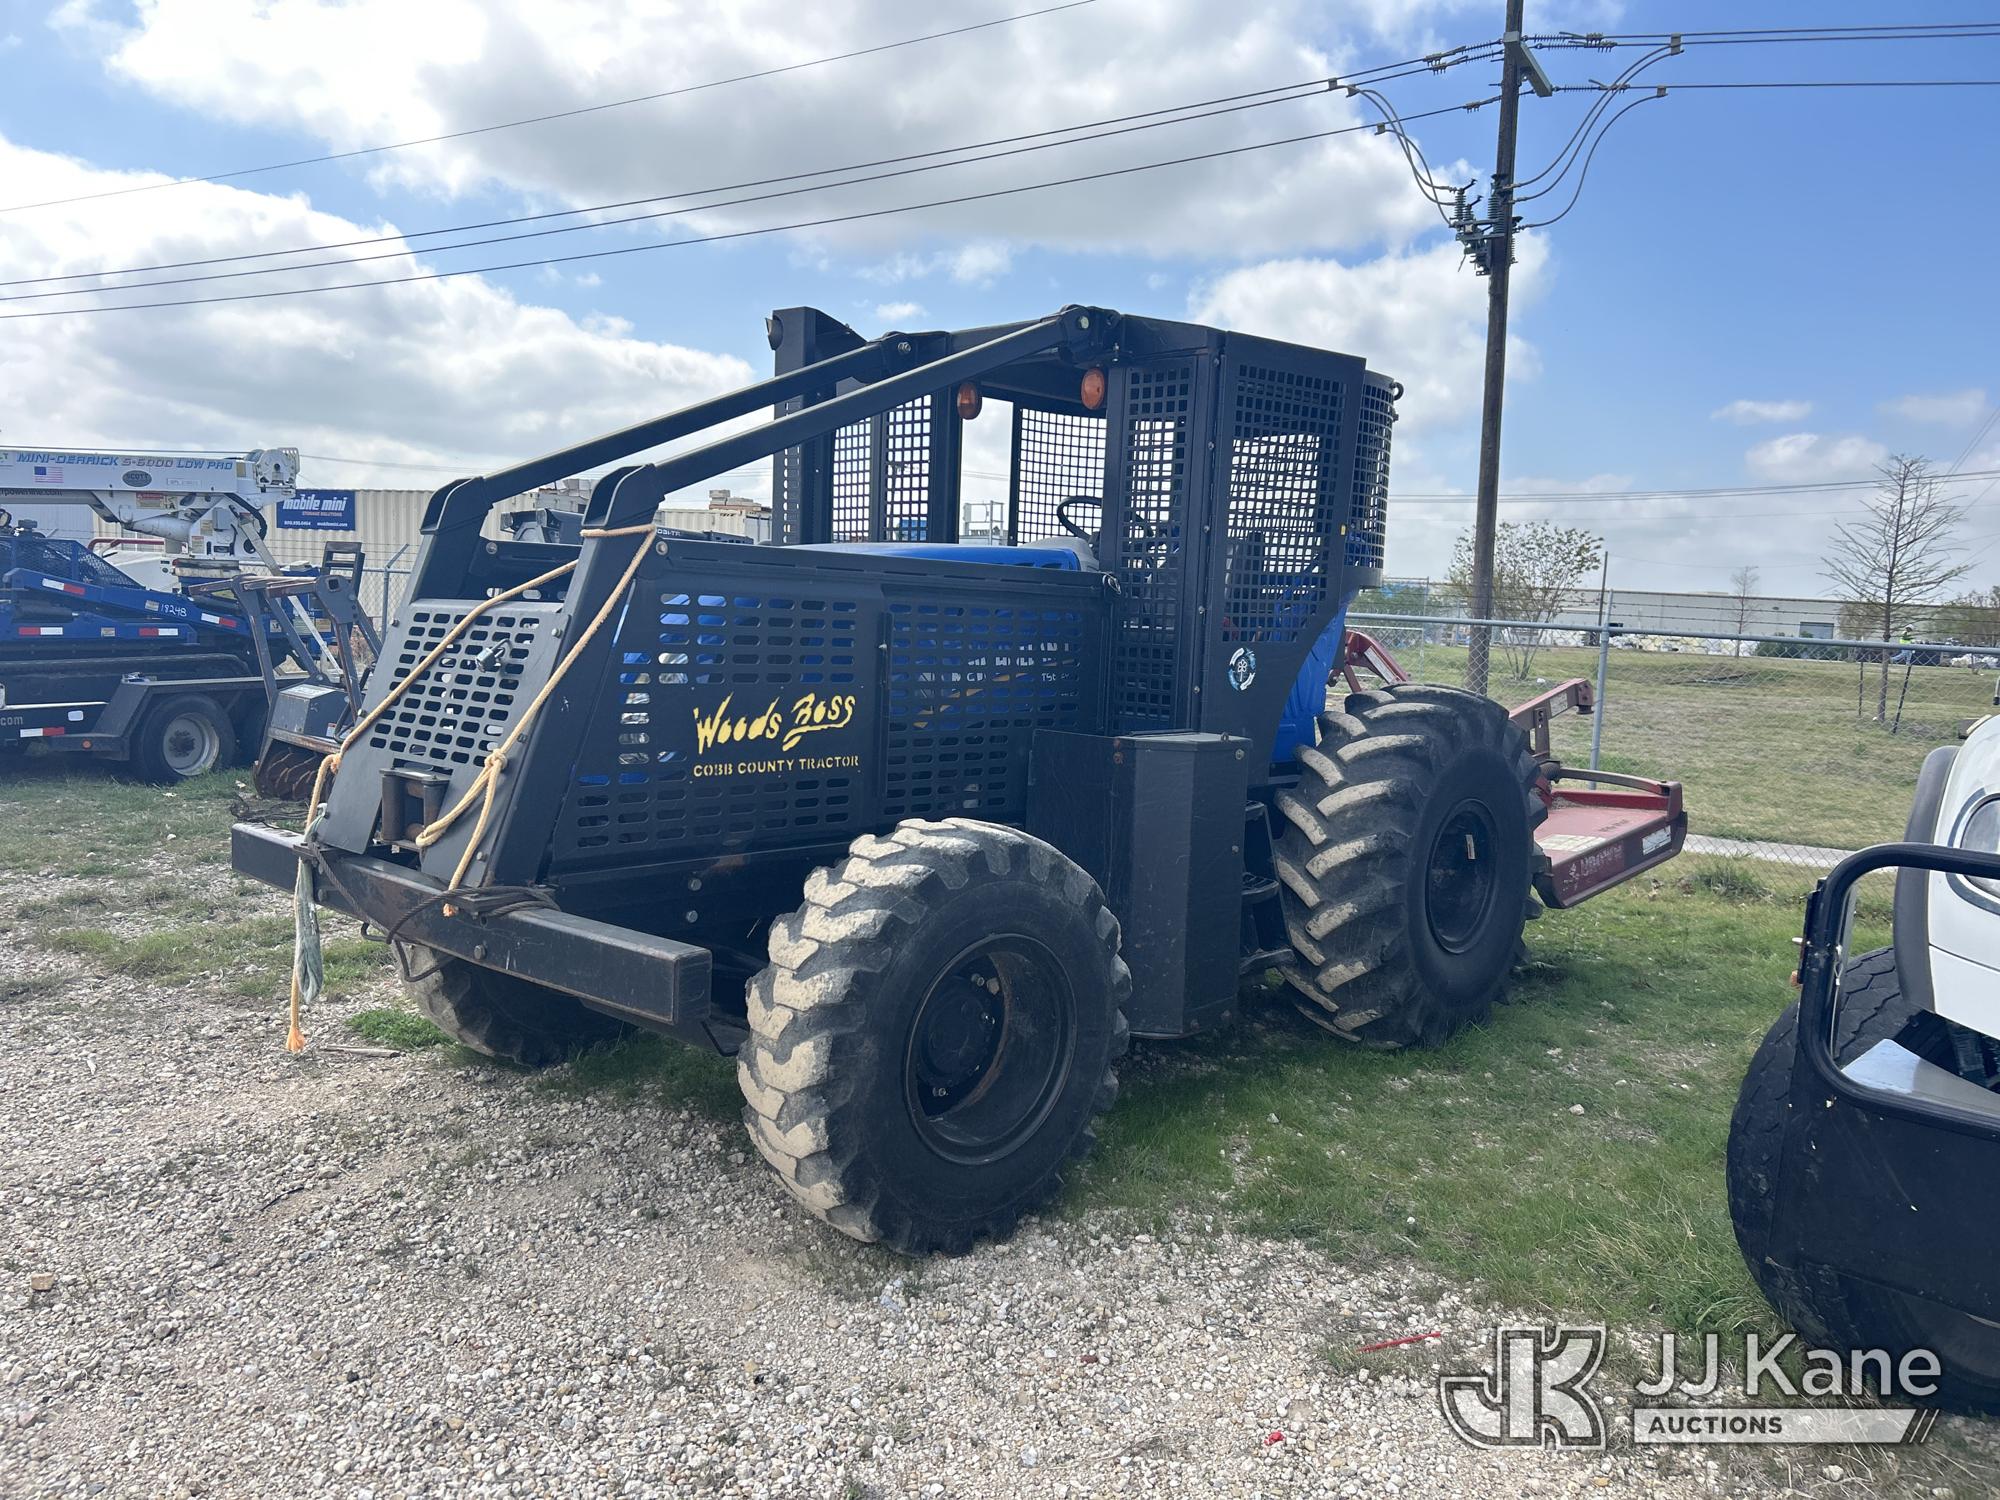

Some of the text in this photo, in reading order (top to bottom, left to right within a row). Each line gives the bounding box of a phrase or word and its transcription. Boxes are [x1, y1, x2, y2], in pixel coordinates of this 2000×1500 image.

[17, 453, 119, 466] MINI-DERRICK
[176, 460, 205, 469] LOW
[207, 461, 233, 470] PRO
[283, 494, 348, 511] mobile mini
[160, 603, 187, 617] 18248
[693, 692, 782, 755] Woods
[693, 755, 859, 777] COBB COUNTY TRACTOR
